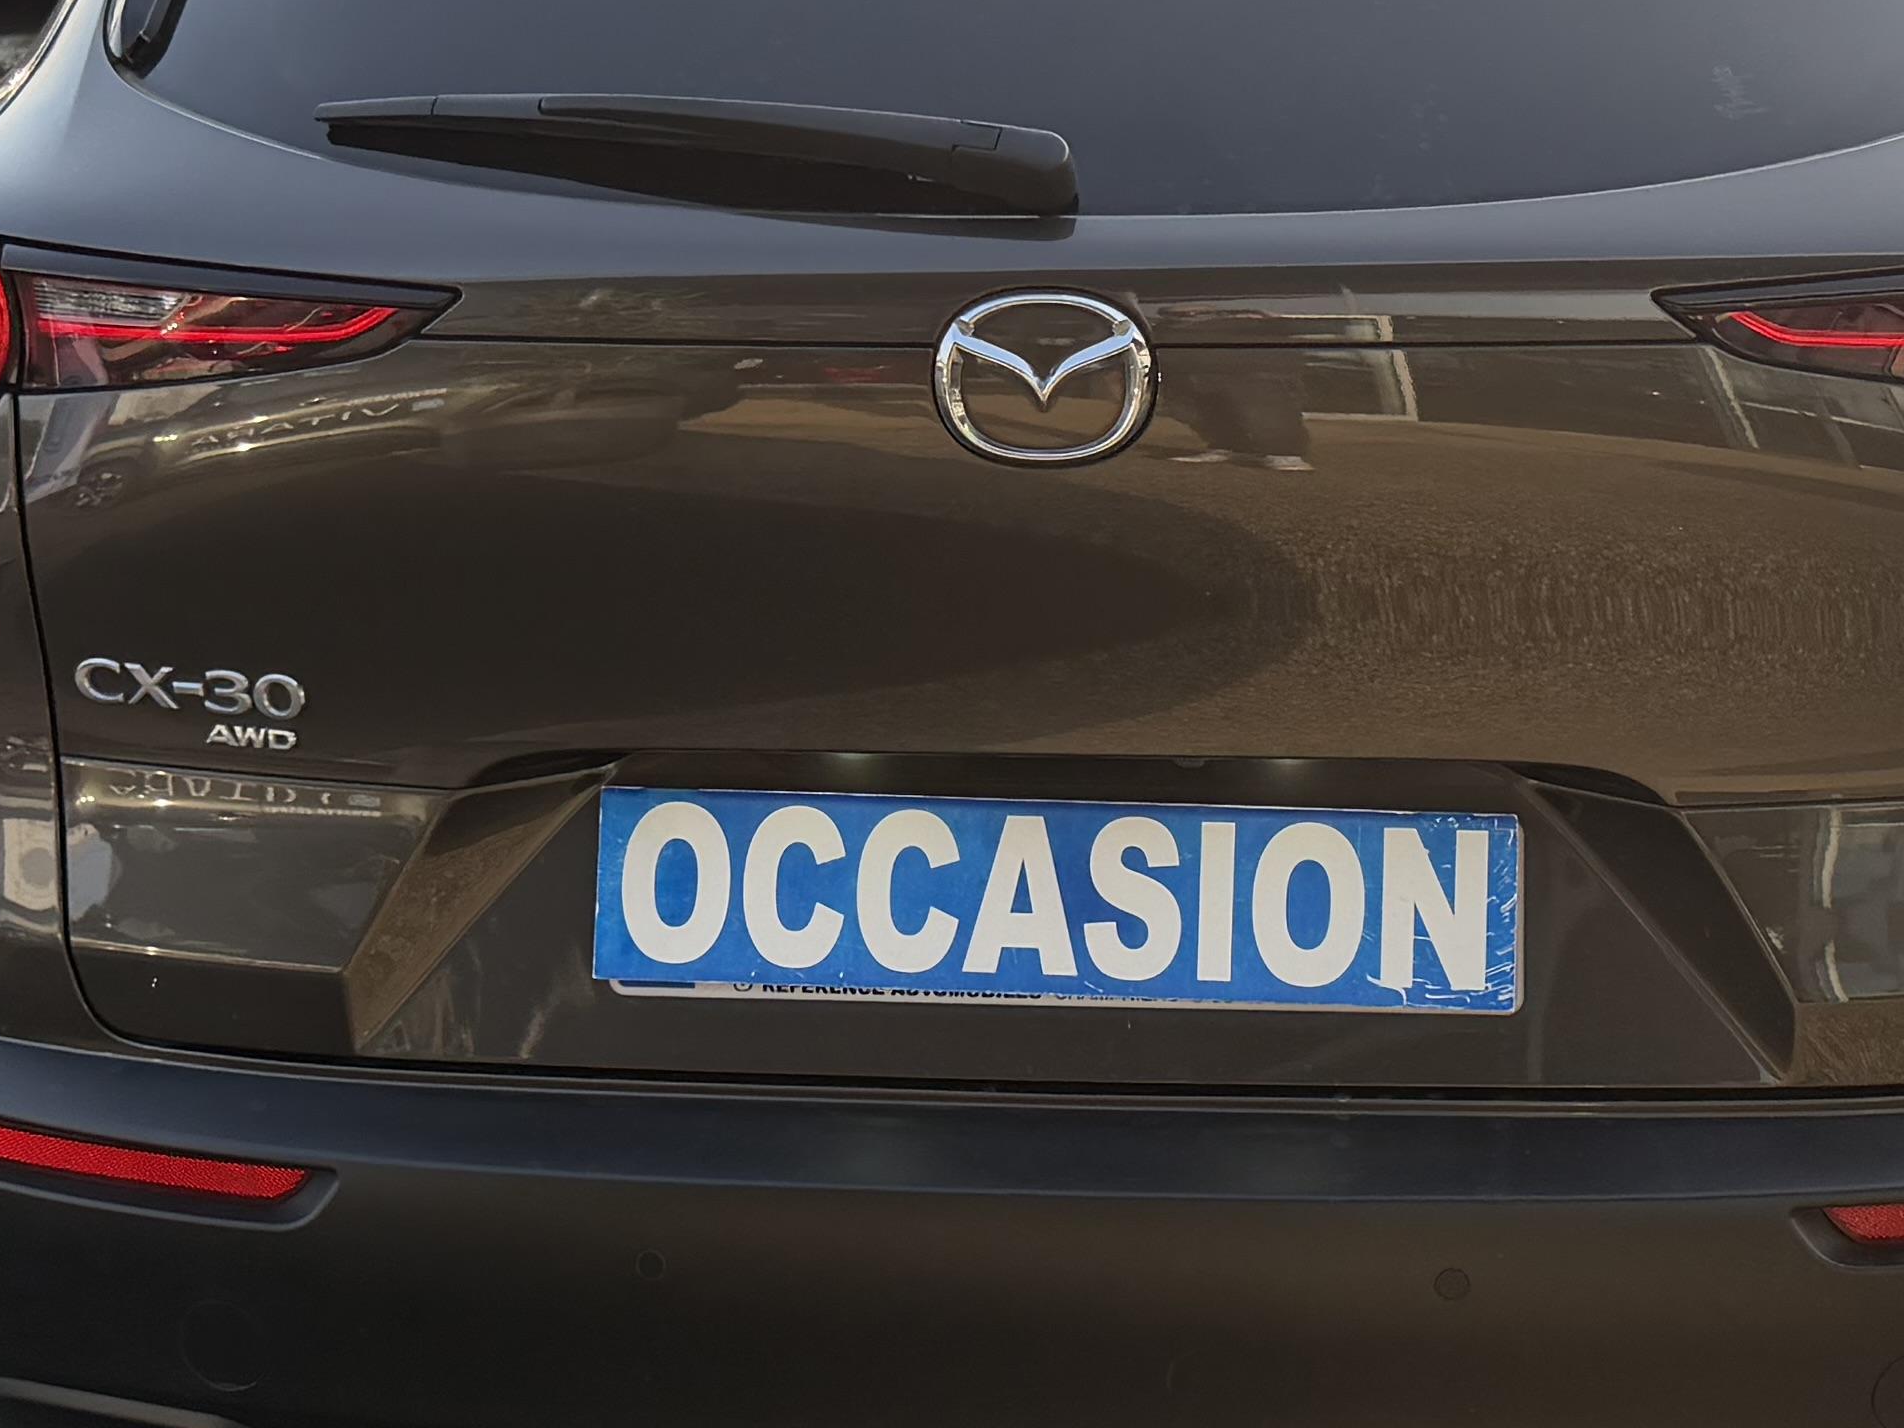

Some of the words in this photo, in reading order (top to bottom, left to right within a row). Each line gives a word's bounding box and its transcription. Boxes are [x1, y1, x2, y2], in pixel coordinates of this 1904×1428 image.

[74, 657, 306, 720] CX-30
[205, 723, 297, 750] AWD
[620, 800, 1490, 992] OCCASION
